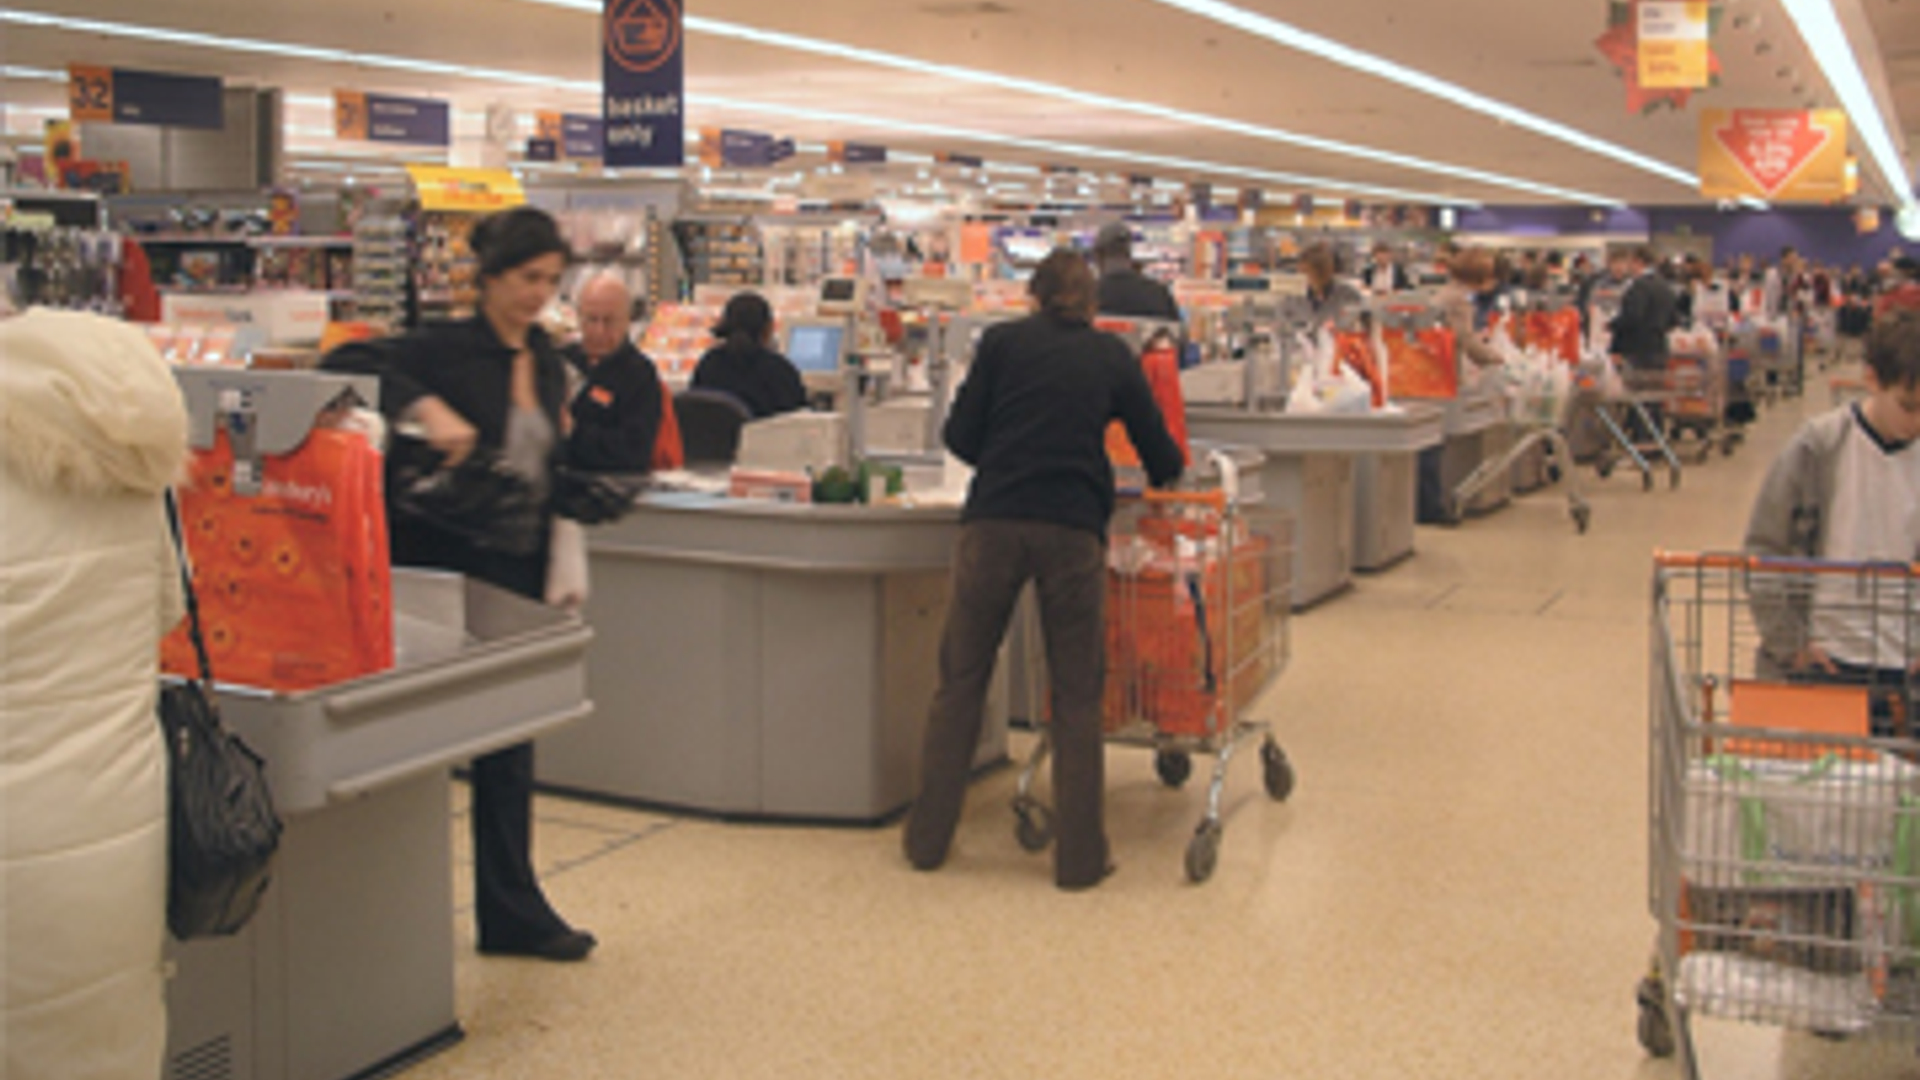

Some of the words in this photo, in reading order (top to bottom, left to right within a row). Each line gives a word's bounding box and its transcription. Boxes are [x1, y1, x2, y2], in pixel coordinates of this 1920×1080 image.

[74, 76, 109, 108] 32
[607, 94, 679, 117] basket
[607, 124, 655, 147] only
